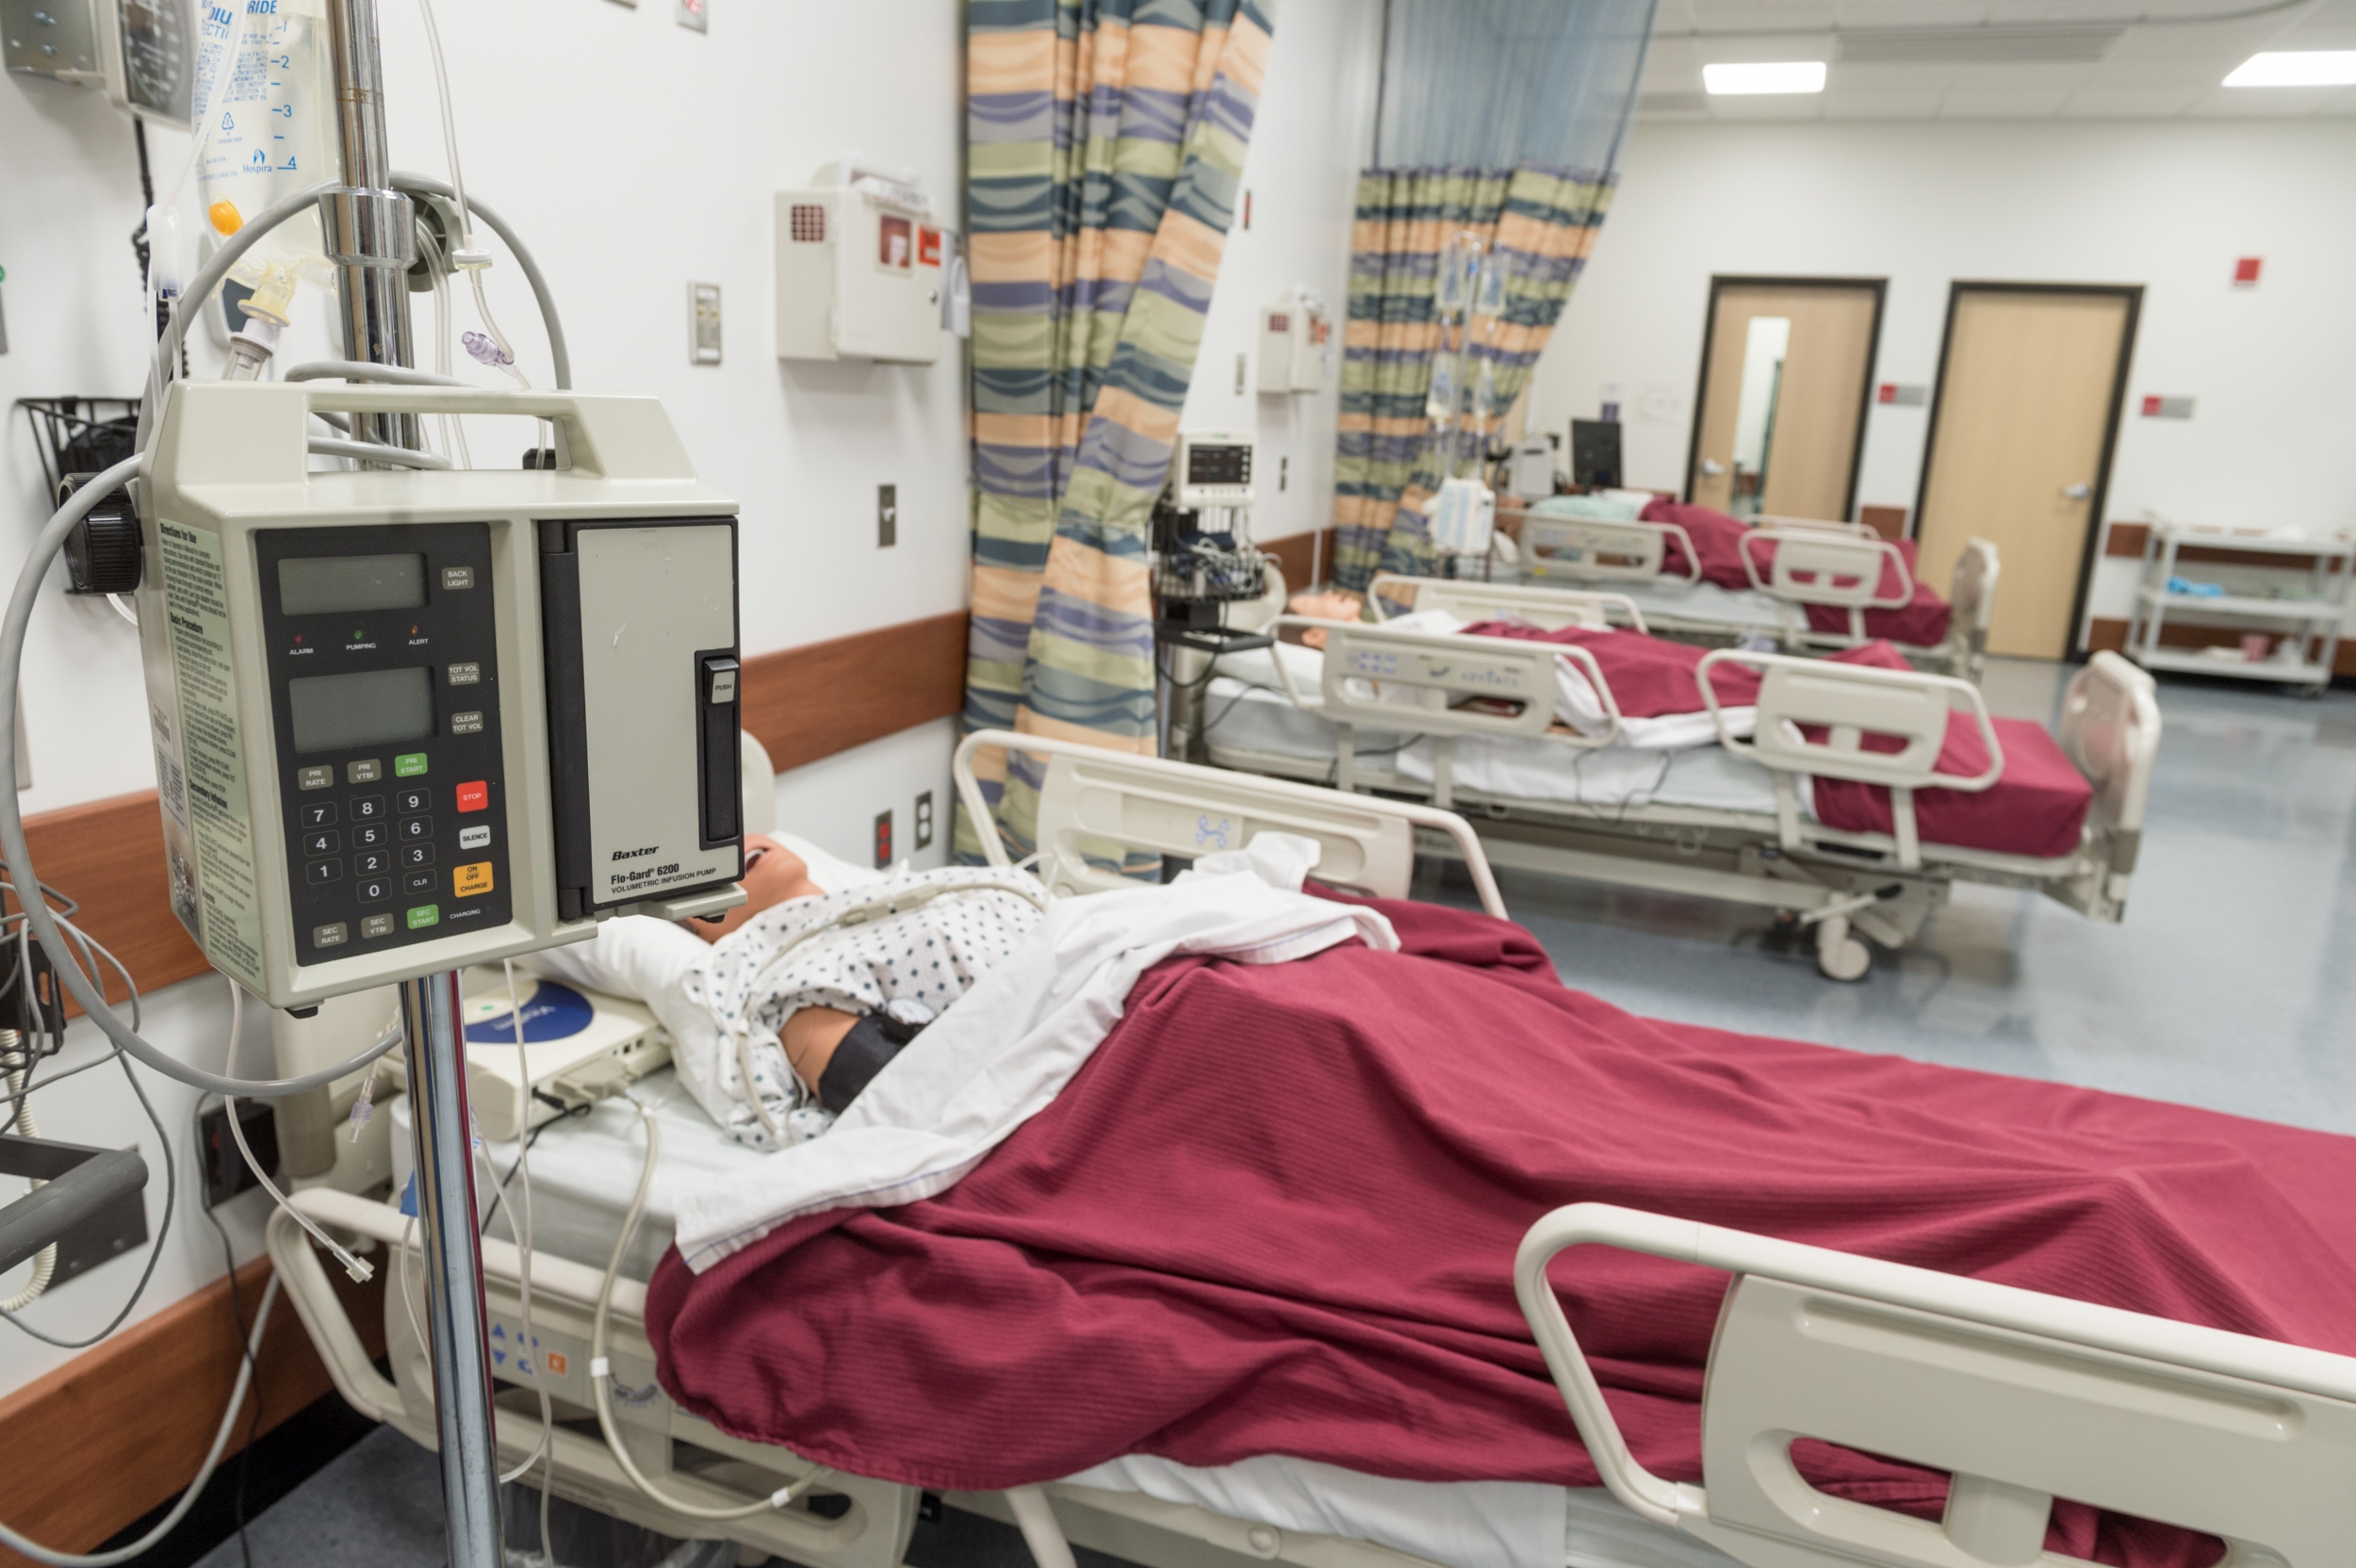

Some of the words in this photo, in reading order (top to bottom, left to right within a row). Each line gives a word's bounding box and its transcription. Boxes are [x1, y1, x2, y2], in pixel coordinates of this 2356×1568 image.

[281, 55, 289, 69] 2
[284, 104, 292, 118] 3
[287, 155, 297, 169] 4
[242, 164, 272, 174] Hospira
[455, 714, 479, 723] CLEAR
[400, 765, 423, 774] START
[305, 778, 326, 787] RATE
[408, 795, 419, 808] 9
[463, 792, 482, 801] STOP
[362, 802, 373, 814] 8
[314, 809, 324, 822] 7
[410, 823, 421, 834] 6
[365, 830, 375, 842] 5
[463, 832, 488, 841] SILENCE
[316, 838, 327, 849] 4
[413, 850, 423, 861] 3
[612, 846, 660, 861] Baxter
[367, 857, 377, 869] 2
[319, 866, 328, 877] 1
[657, 863, 679, 876] 6200
[413, 878, 428, 887] CLR
[466, 873, 480, 881] OFF
[612, 879, 660, 894] VOLUMETRIC
[661, 873, 695, 885] INFUSION
[695, 867, 717, 878] PUMP
[368, 885, 380, 897] 0
[460, 882, 488, 892] CHARGE
[450, 908, 481, 919] CHARGING
[370, 918, 385, 926] SEC
[413, 917, 434, 926] START
[322, 927, 337, 936] SEC
[321, 936, 340, 944] RATE
